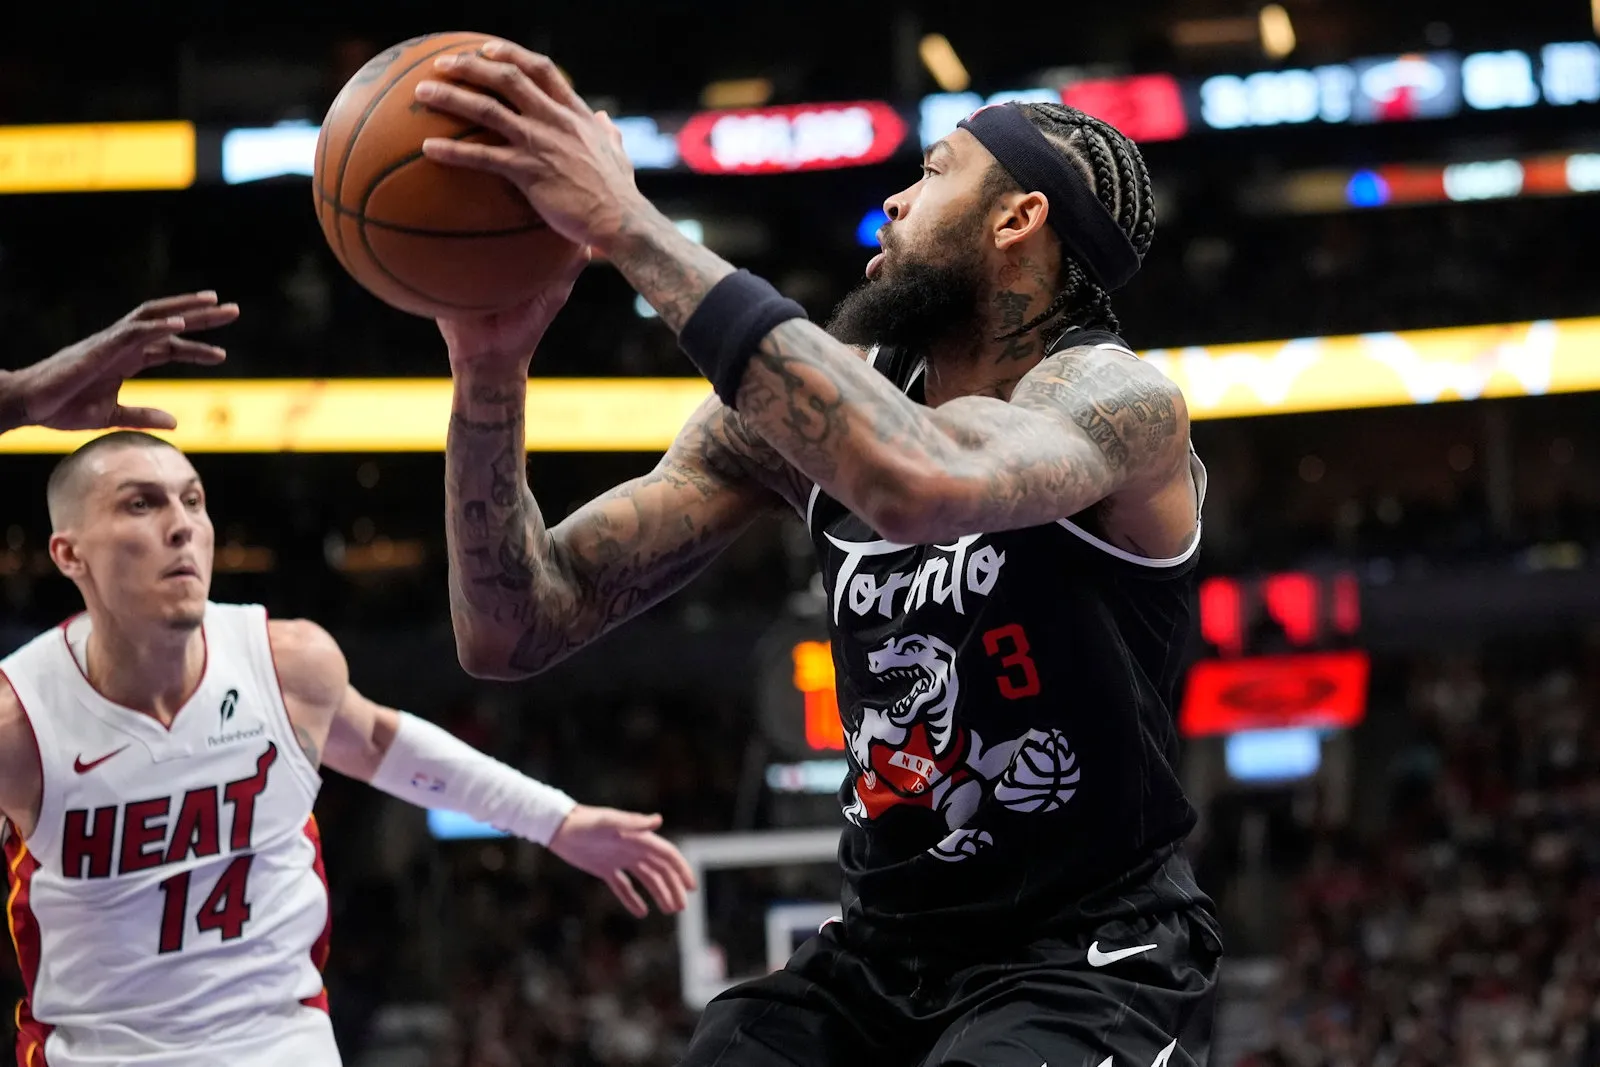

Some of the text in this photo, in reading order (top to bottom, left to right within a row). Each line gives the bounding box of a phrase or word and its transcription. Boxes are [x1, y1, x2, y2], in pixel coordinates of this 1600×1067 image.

[982, 623, 1040, 700] 3
[207, 721, 264, 748] Robinhood
[61, 740, 278, 881] HEAT
[158, 853, 256, 956] 14
